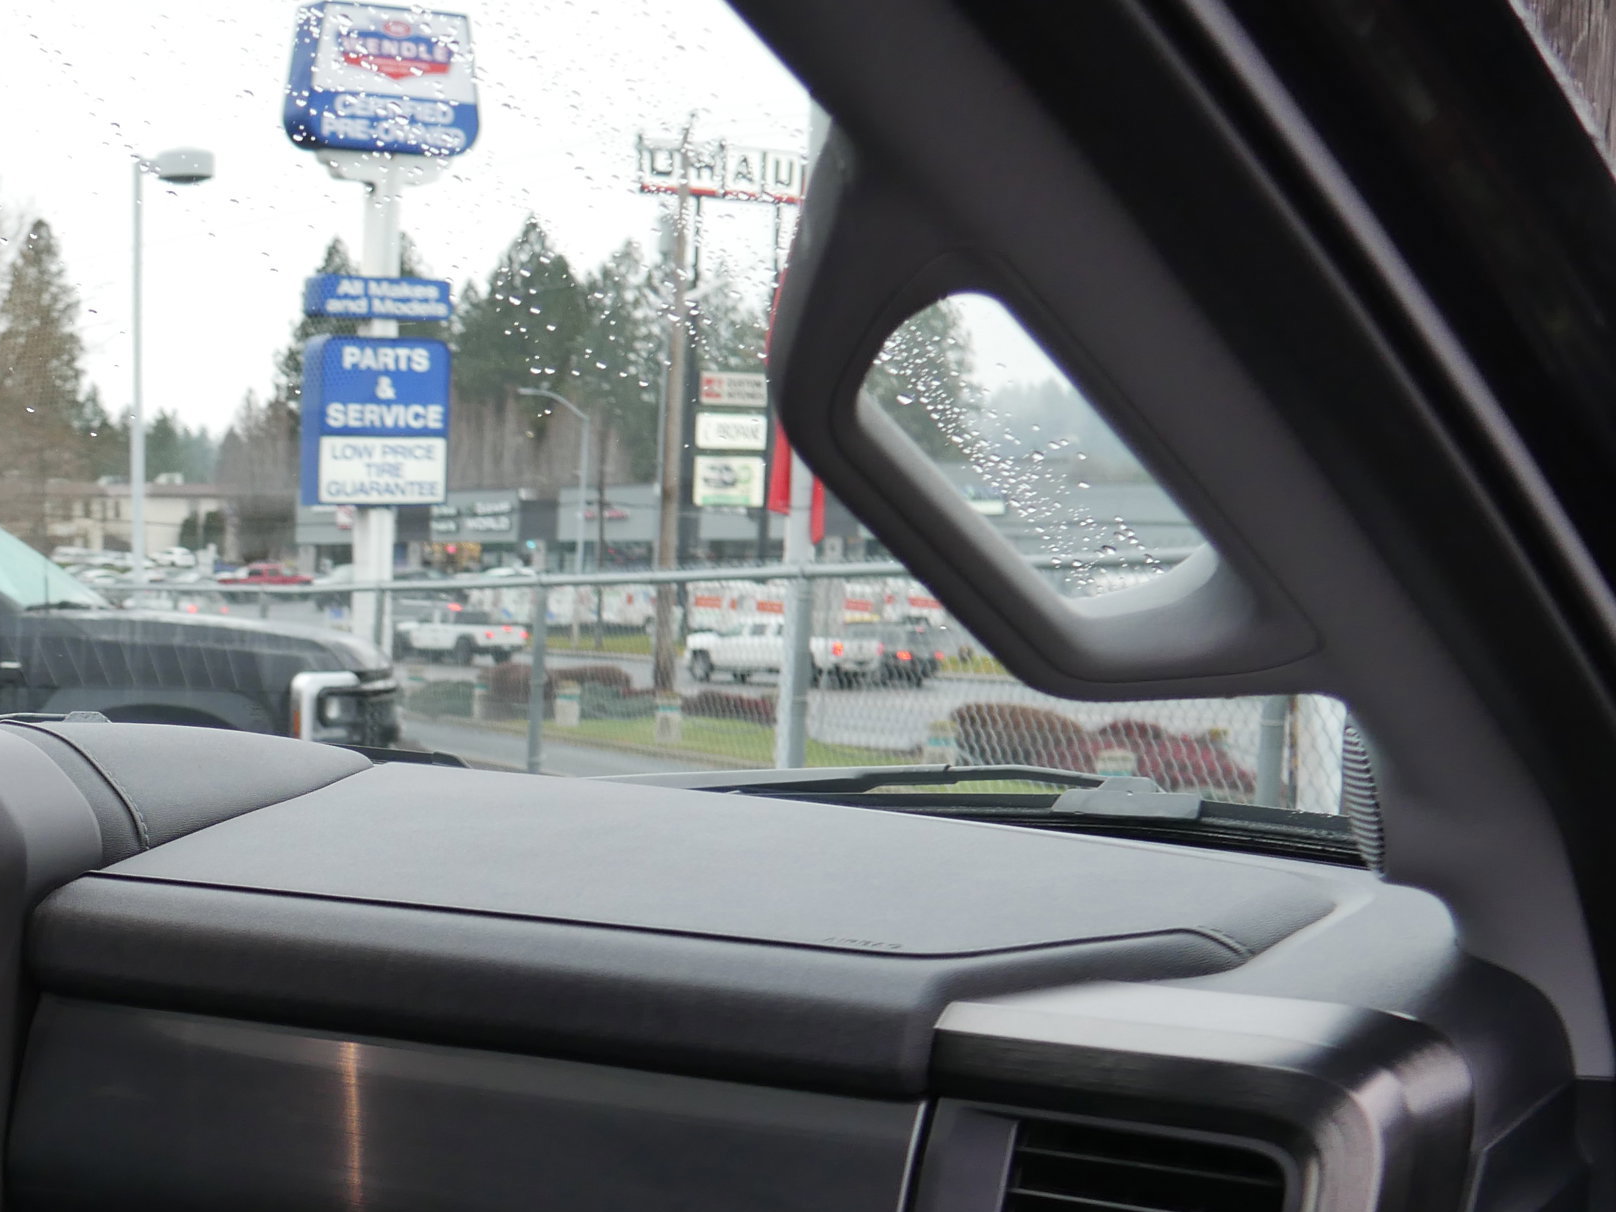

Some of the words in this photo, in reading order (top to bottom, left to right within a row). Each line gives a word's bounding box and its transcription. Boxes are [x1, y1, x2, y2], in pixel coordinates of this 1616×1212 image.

[341, 35, 452, 63] WENDLE
[336, 278, 364, 297] All
[367, 279, 440, 299] Makes
[325, 297, 368, 314] and
[370, 298, 449, 317] Models
[341, 346, 431, 372] PARTS
[374, 376, 396, 400] &
[325, 403, 444, 430] SERVICE
[331, 444, 369, 460] LOW
[377, 445, 437, 461] PRICE
[364, 463, 404, 478] TIRE
[326, 481, 444, 498] GUARANTEE
